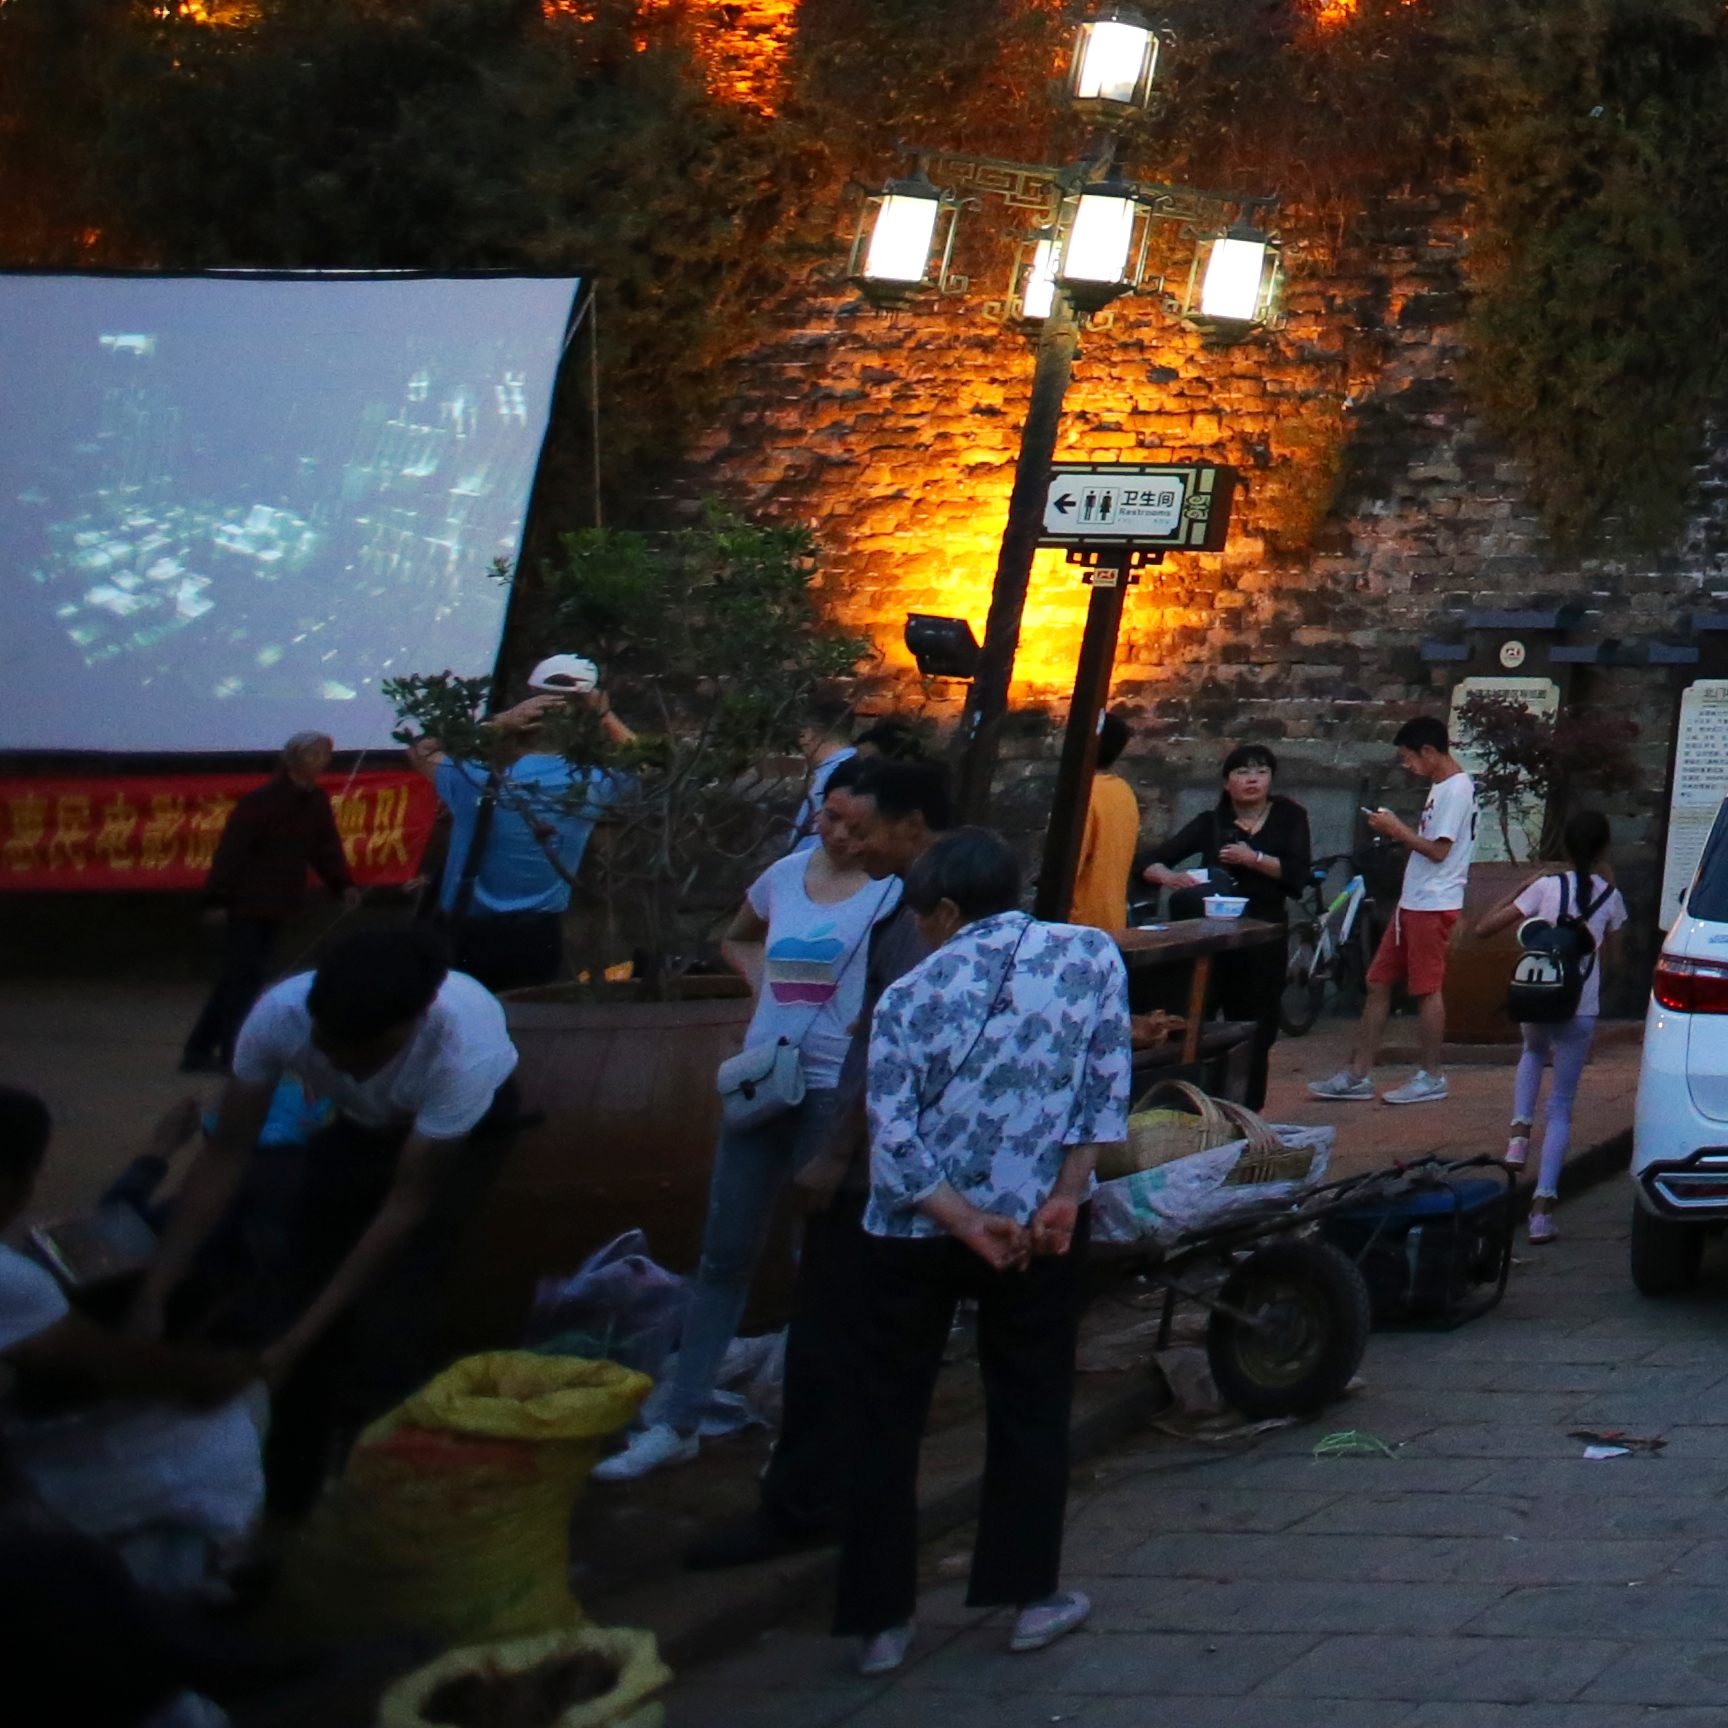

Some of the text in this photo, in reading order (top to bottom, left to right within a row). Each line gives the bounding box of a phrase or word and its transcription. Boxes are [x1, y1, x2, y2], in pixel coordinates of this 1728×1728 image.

[1121, 490, 1175, 507] 卫生间
[1119, 507, 1171, 517] Restrooms
